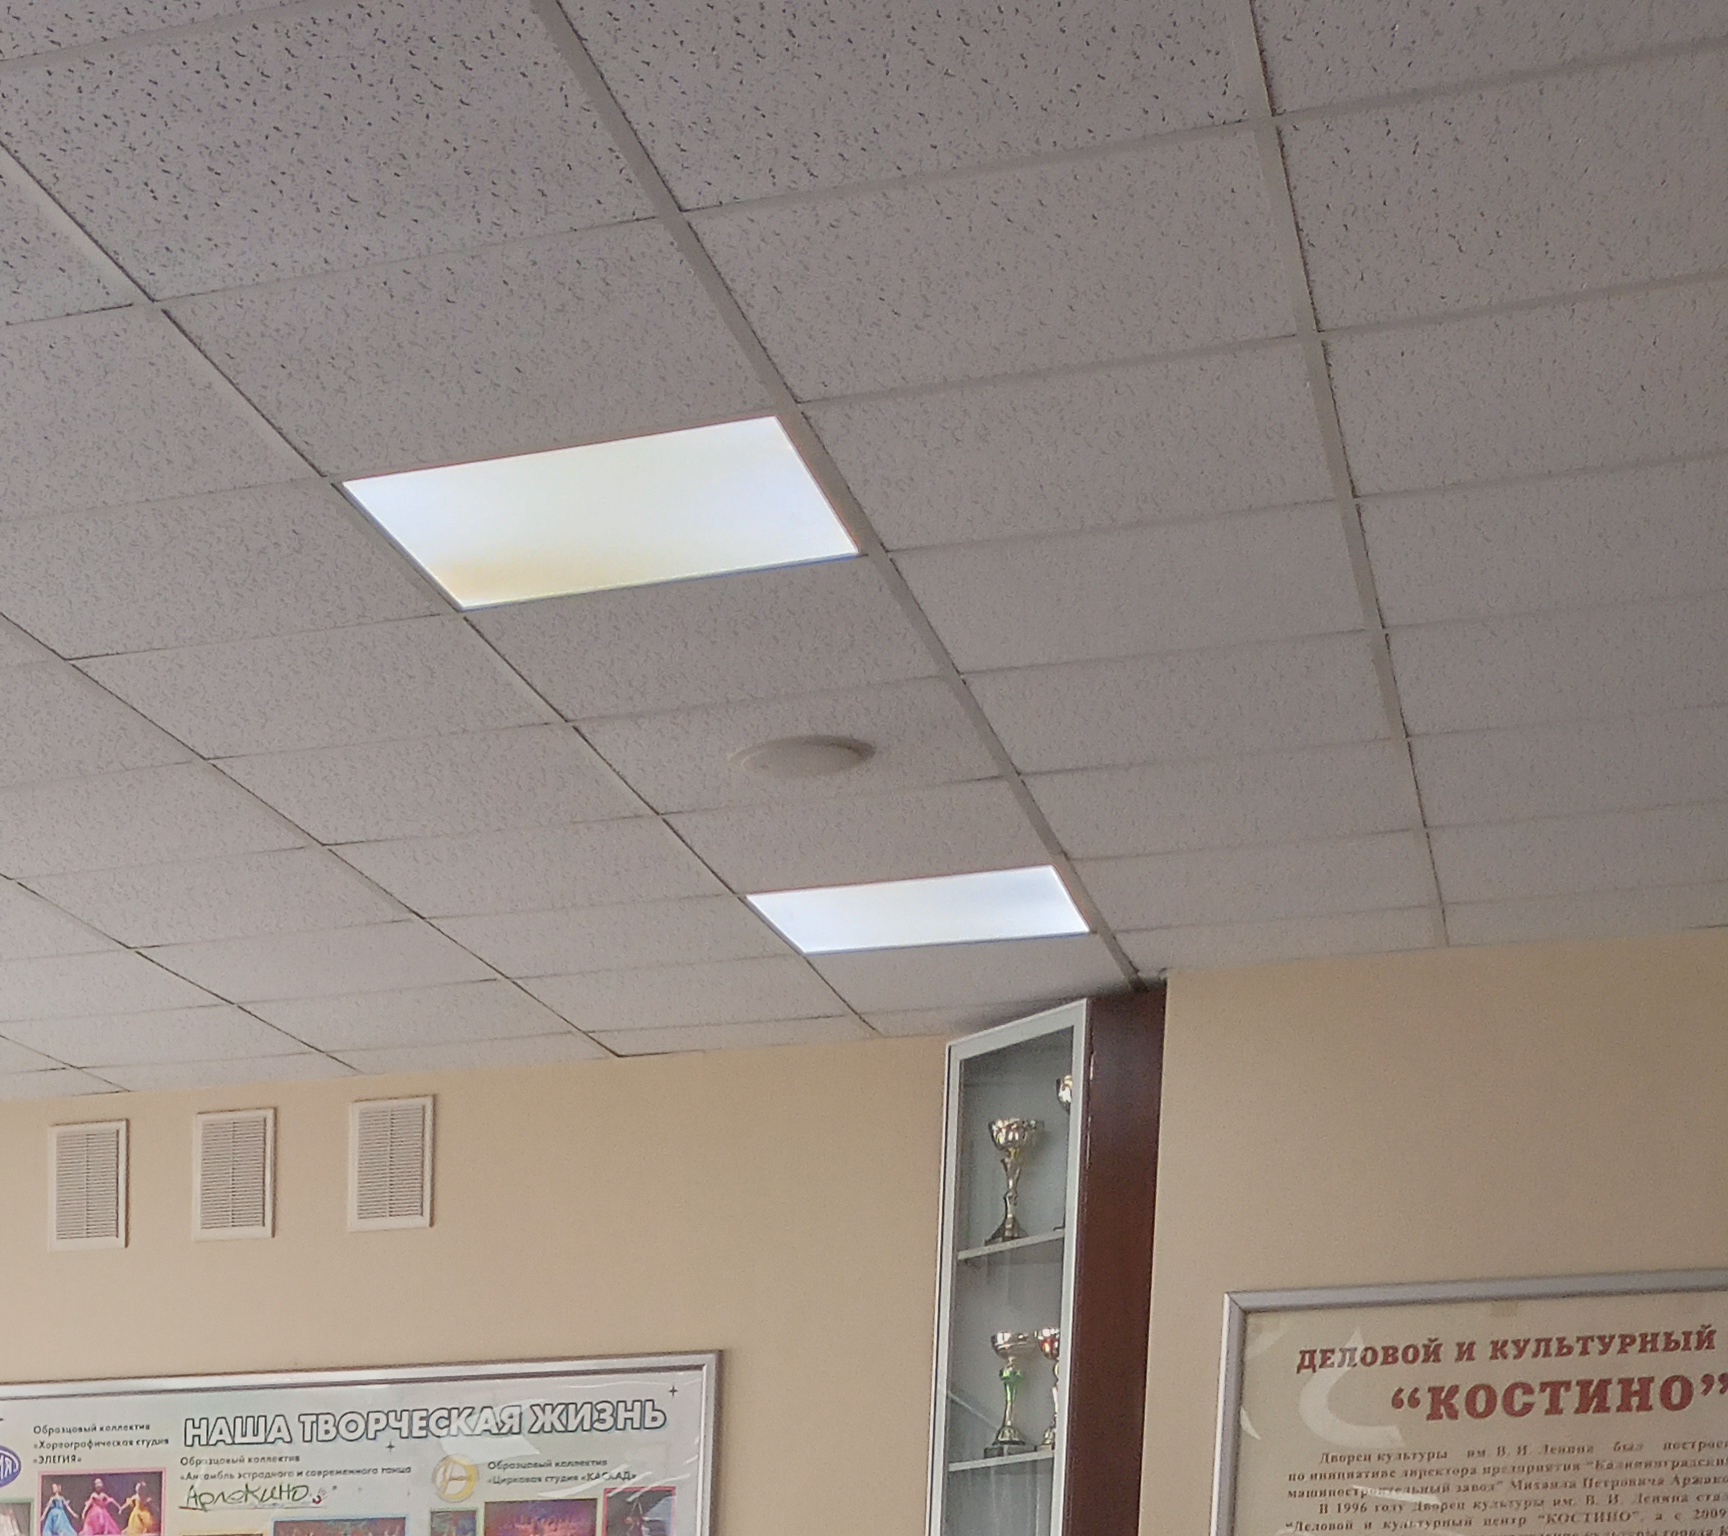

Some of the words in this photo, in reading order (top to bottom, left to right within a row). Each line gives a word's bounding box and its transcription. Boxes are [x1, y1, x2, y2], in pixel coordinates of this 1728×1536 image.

[1296, 1337, 1442, 1374] ДЕЛОВОЙ
[1455, 1340, 1477, 1361] И
[1489, 1324, 1718, 1361] КУЛЬТУРНЫЙ
[184, 1414, 293, 1448] НАША
[298, 1404, 522, 1442] ТВОРЧЕСКАЯ
[528, 1399, 668, 1435] ЖИЗНЬ
[1336, 1502, 1368, 1514] 1996
